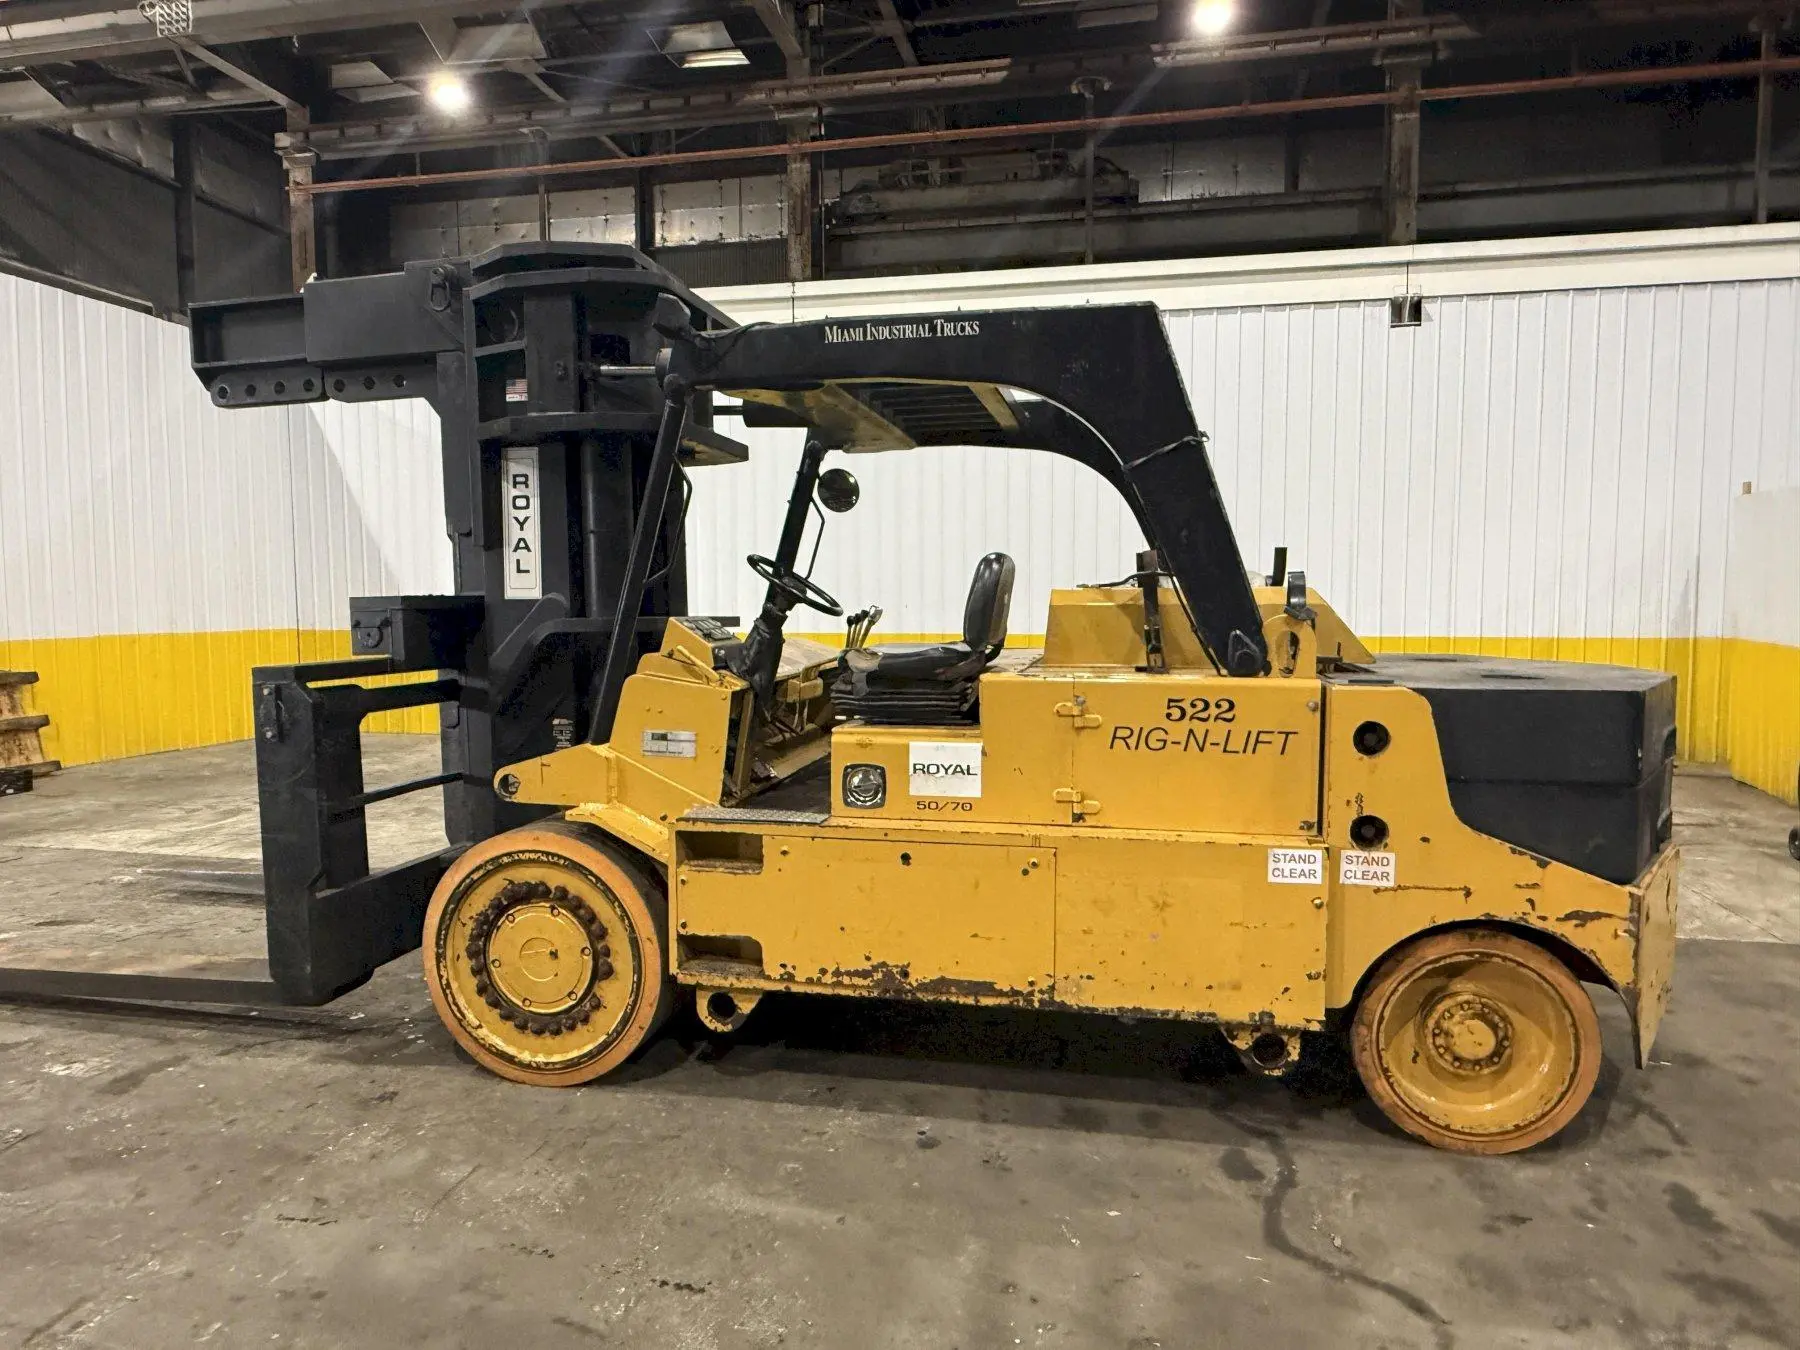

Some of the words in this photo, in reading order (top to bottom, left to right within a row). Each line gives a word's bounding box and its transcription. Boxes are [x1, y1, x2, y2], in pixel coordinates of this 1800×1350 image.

[824, 325, 864, 343] MIAMI
[865, 323, 933, 341] INDUSTRIAL
[934, 319, 980, 337] TRUCKS
[512, 473, 532, 574] ROYAL
[1165, 697, 1236, 723] 522
[1109, 726, 1299, 756] RIG-N-LIFT
[912, 763, 978, 776] ROYAL
[916, 800, 973, 812] 50/70
[1272, 853, 1317, 865] STAND
[1345, 855, 1390, 867] STAND
[1271, 867, 1317, 880] CLEAR
[1343, 869, 1390, 882] CLEAR
